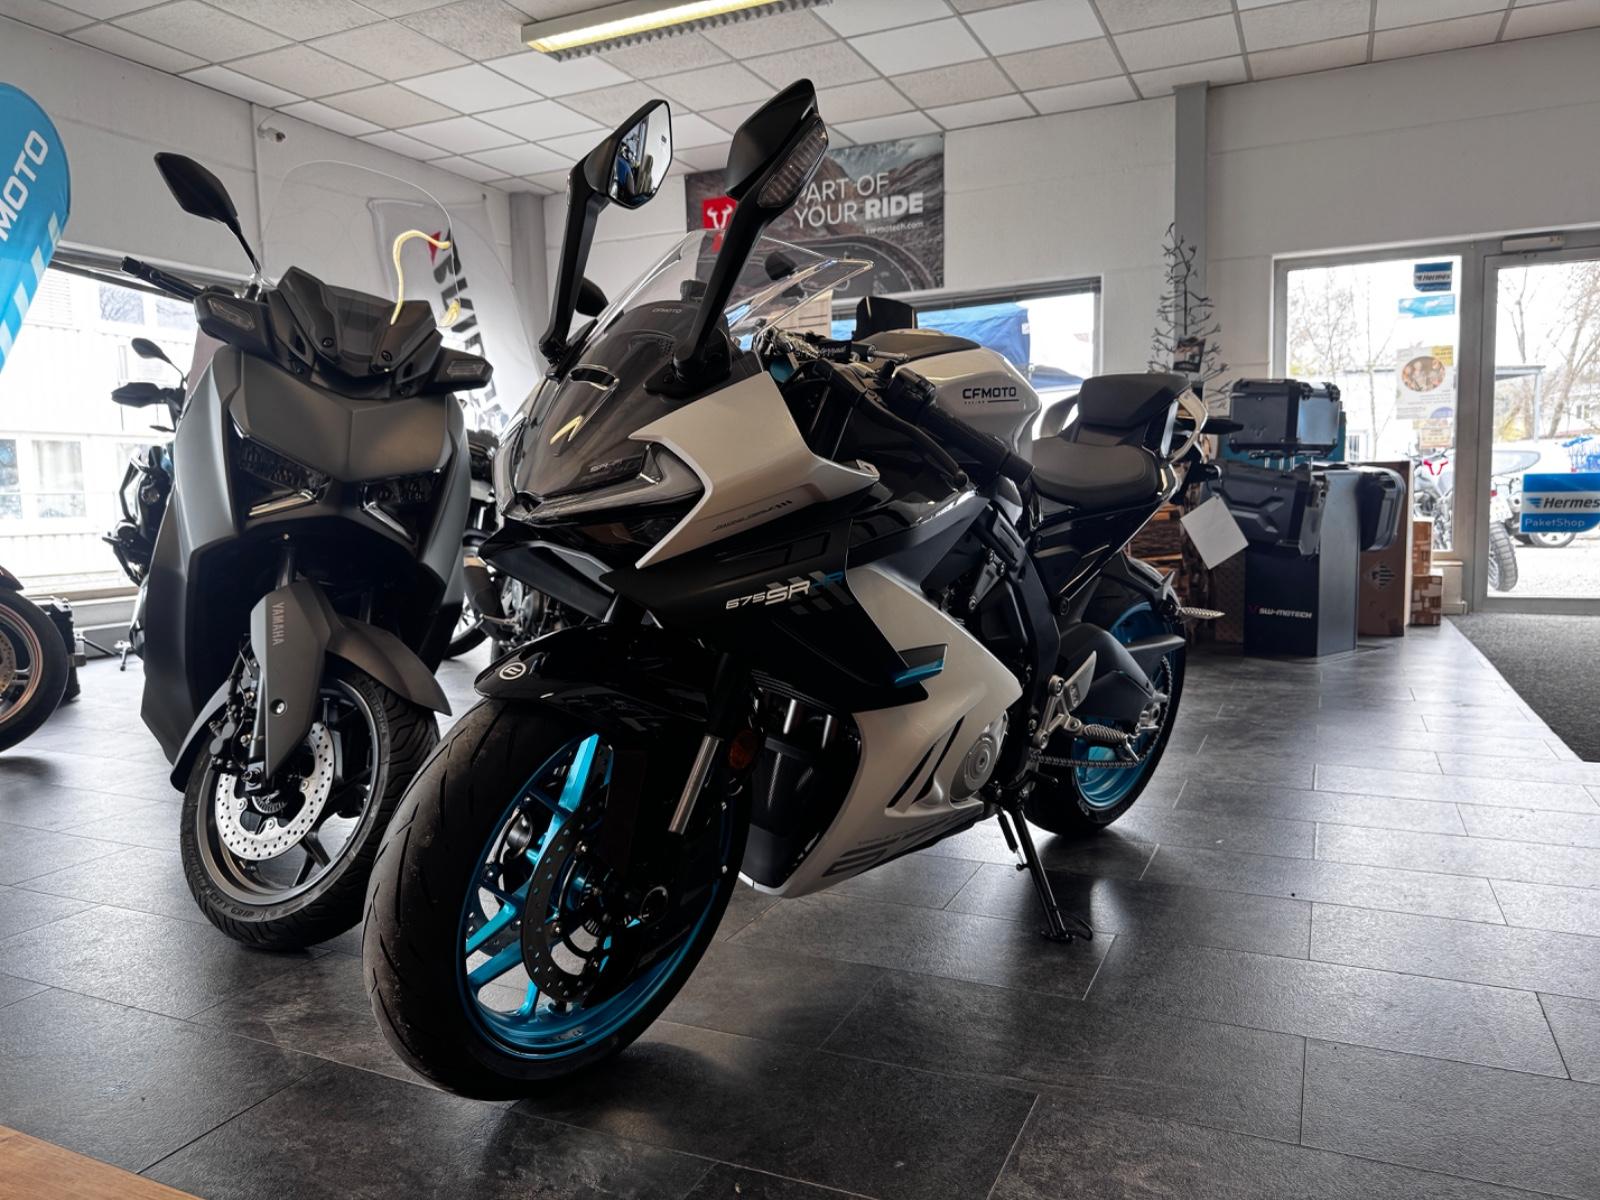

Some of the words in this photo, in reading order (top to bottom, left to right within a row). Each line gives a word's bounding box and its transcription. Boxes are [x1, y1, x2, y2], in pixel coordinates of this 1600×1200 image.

[796, 177, 850, 205] ART
[856, 172, 889, 197] OF
[794, 201, 858, 229] YOUR
[864, 192, 924, 221] RIDE
[962, 386, 1017, 399] CFMOTO
[1543, 497, 1600, 509] Hermes
[1525, 518, 1585, 529] PaketShop
[271, 601, 285, 646] YAMAHA
